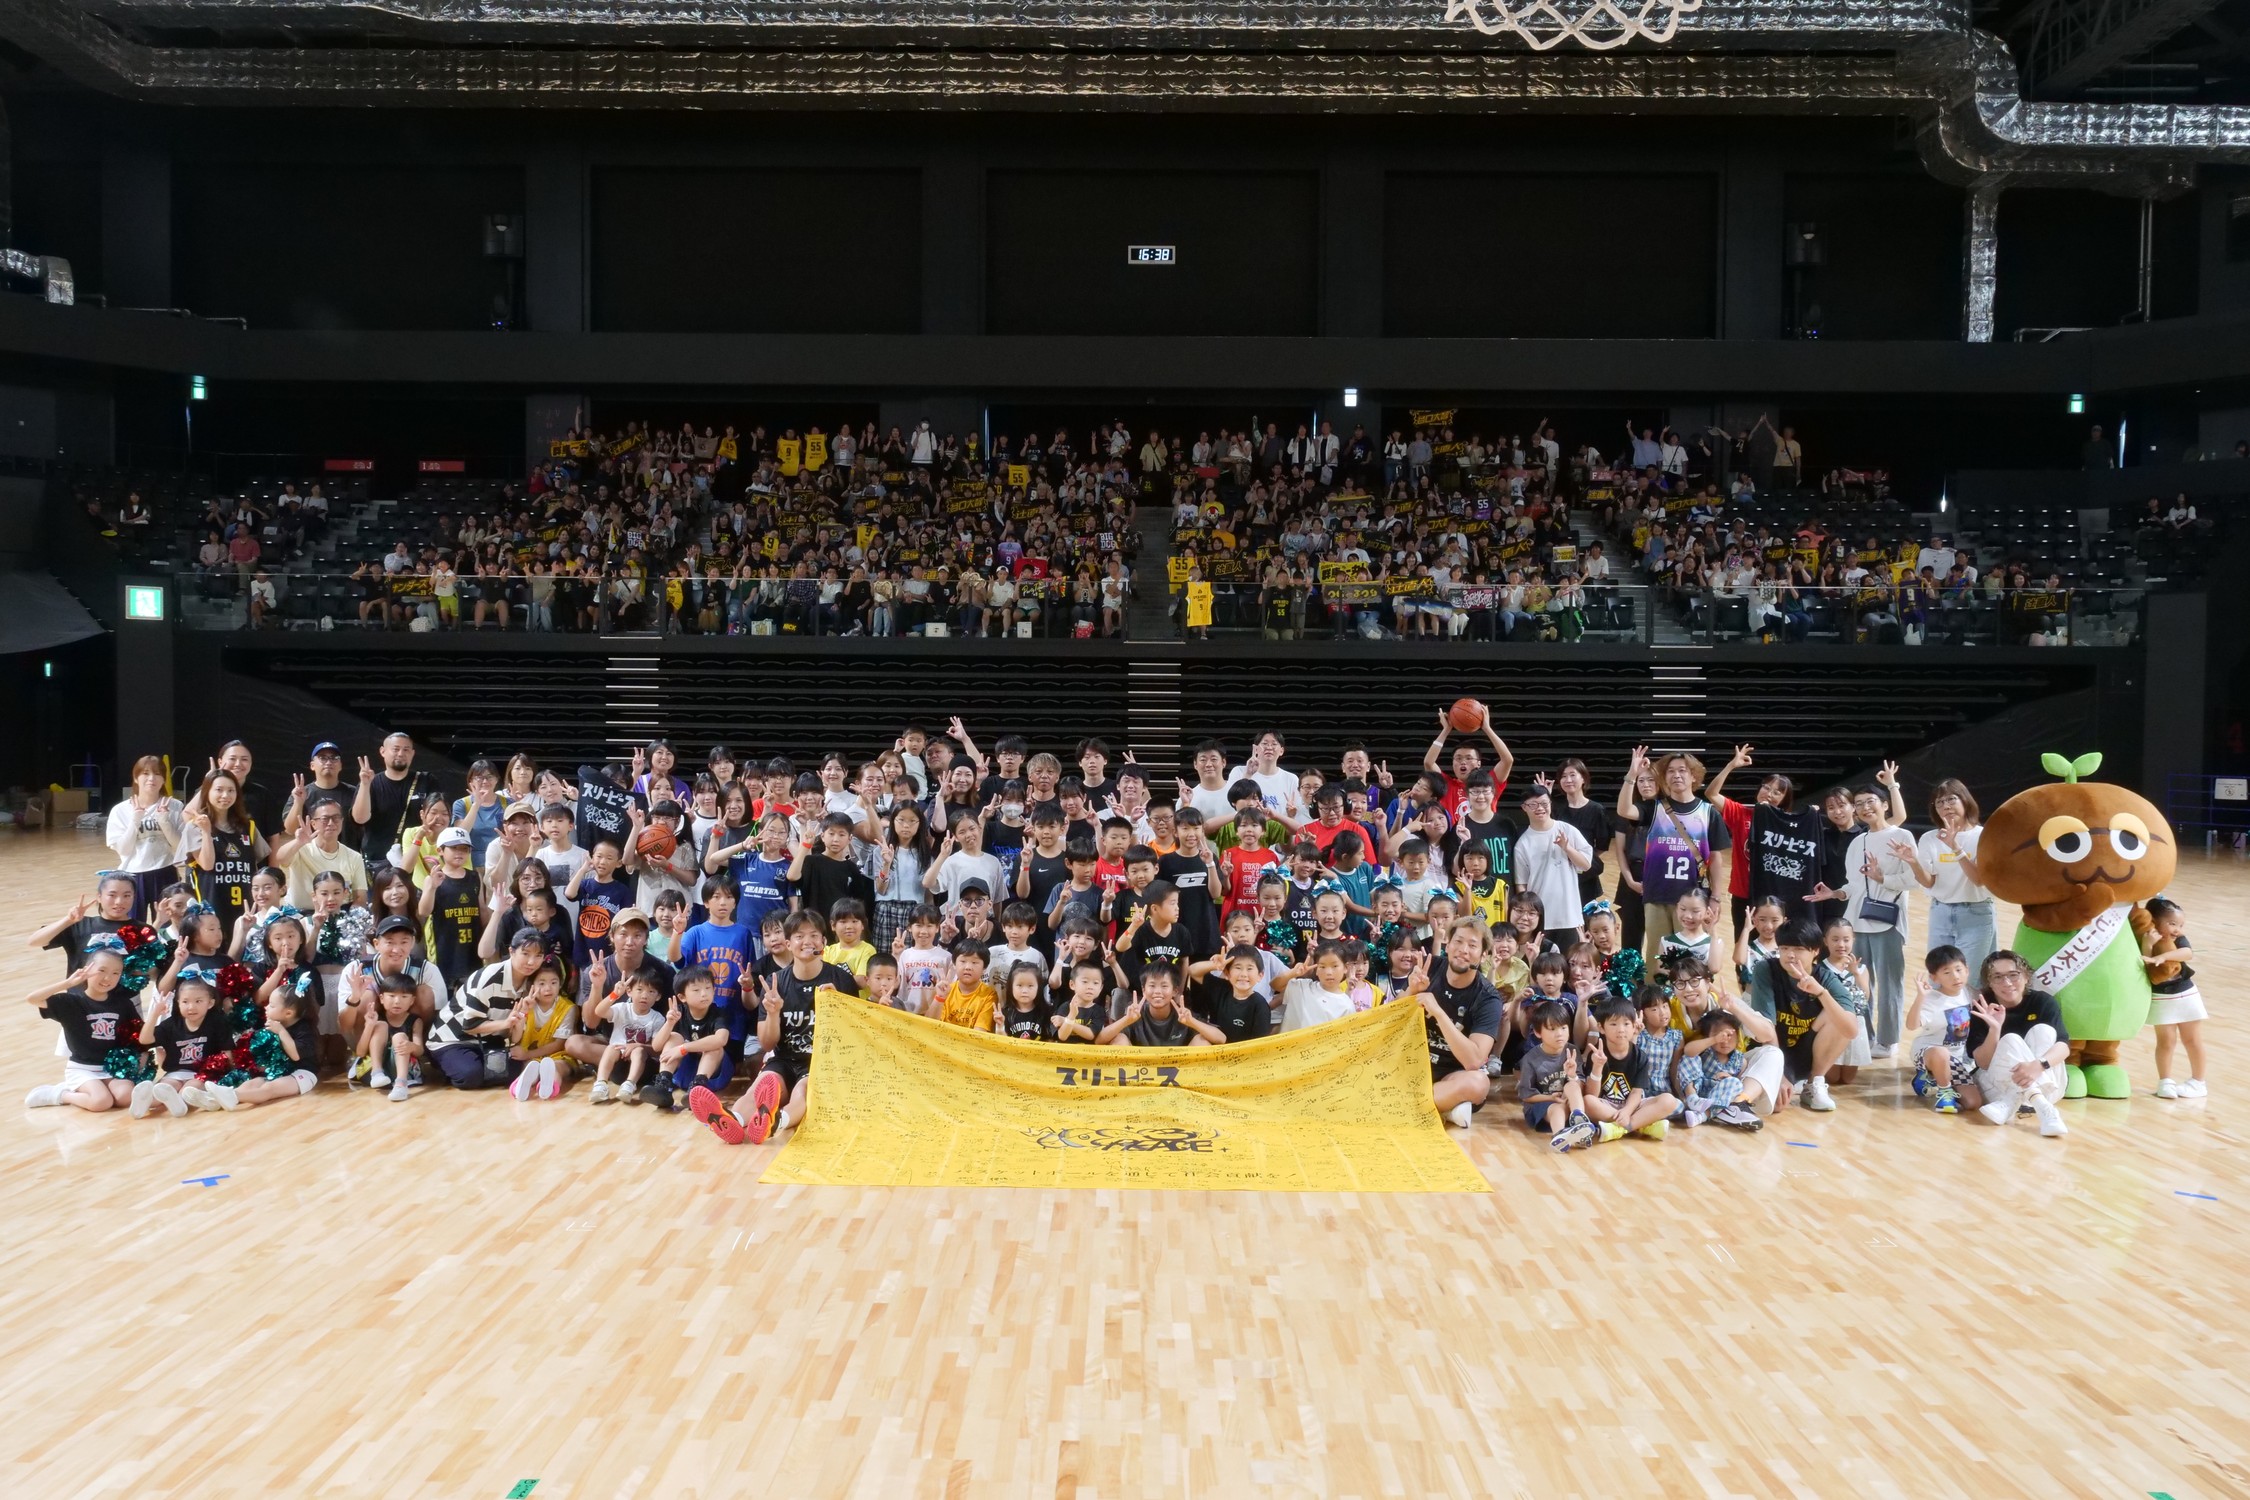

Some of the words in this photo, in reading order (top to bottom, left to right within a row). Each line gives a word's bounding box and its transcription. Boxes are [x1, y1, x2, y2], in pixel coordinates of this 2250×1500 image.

[1138, 248, 1170, 260] 16:38
[785, 447, 792, 457] 9
[811, 442, 821, 452] 55
[1012, 472, 1023, 483] 55
[1477, 499, 1489, 509] 55
[627, 531, 642, 539] BIG
[1100, 532, 1113, 540] BIG
[767, 538, 774, 549] 9
[1005, 557, 1011, 566] 9
[1175, 558, 1188, 570] 55
[1906, 588, 1915, 601] 9
[1277, 608, 1285, 617] 55
[1657, 836, 1676, 845] OPEN
[1677, 837, 1700, 847] HOSE
[1760, 829, 1816, 858] スリーピース
[1669, 844, 1689, 852] GROUP
[215, 861, 250, 873] OPEN
[1664, 856, 1690, 881] 12
[215, 874, 251, 884] HOUSE
[1101, 873, 1127, 882] UNDE
[231, 885, 242, 906] 9
[444, 908, 463, 918] OPEN
[1291, 910, 1315, 920] OPE
[581, 912, 609, 931] KNICKS
[1292, 920, 1317, 928] OUSE
[1145, 945, 1181, 958] THUNDERS
[905, 961, 940, 969] SUNSUN
[1056, 1066, 1181, 1088] スリーピース
